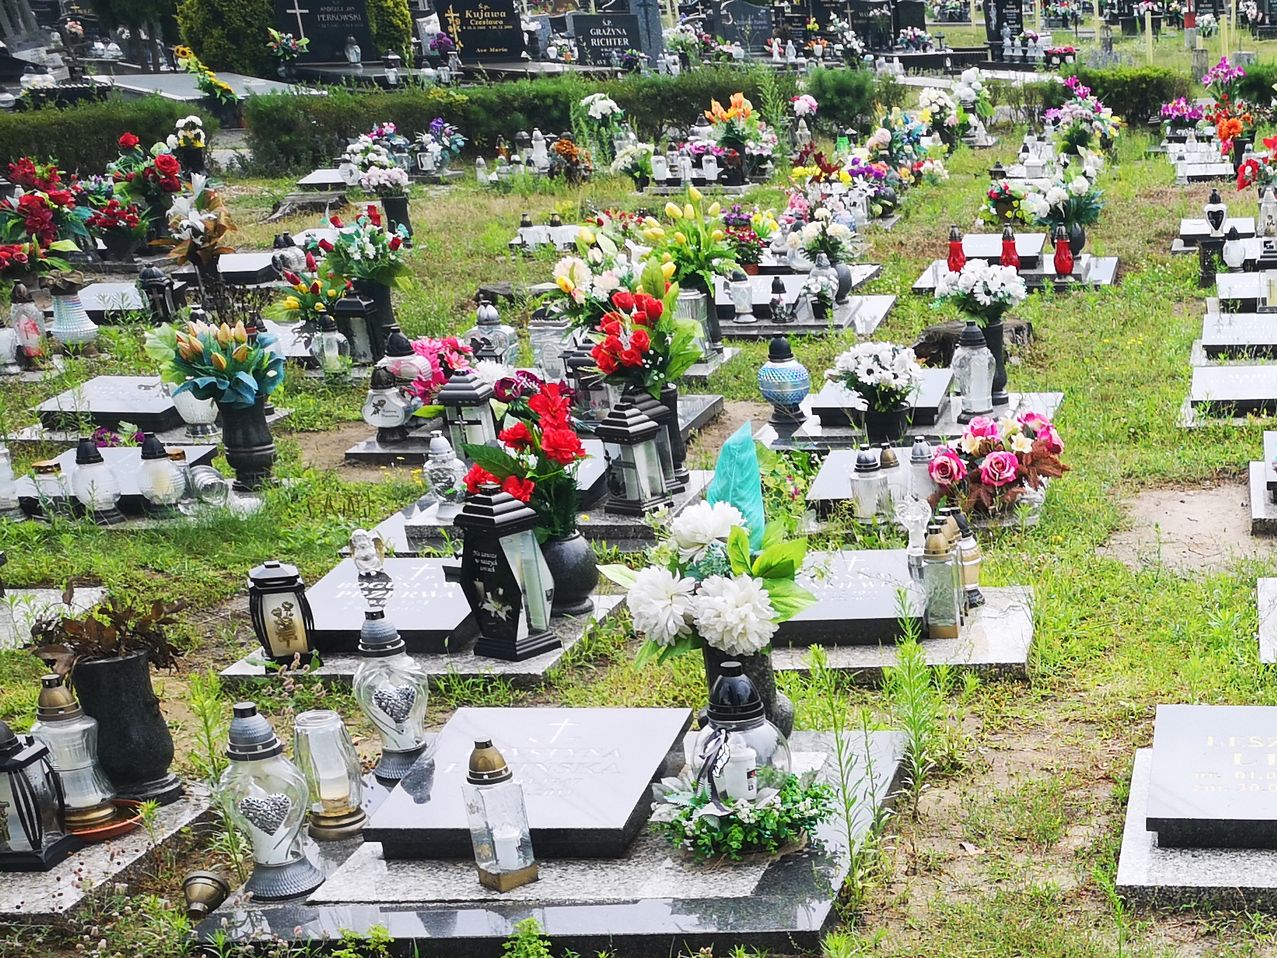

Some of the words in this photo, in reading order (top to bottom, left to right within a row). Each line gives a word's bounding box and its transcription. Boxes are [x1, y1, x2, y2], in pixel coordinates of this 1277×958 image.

[465, 10, 507, 19] Kujawa
[590, 26, 628, 36] GRAŻYNA
[591, 38, 630, 47] RICHTER
